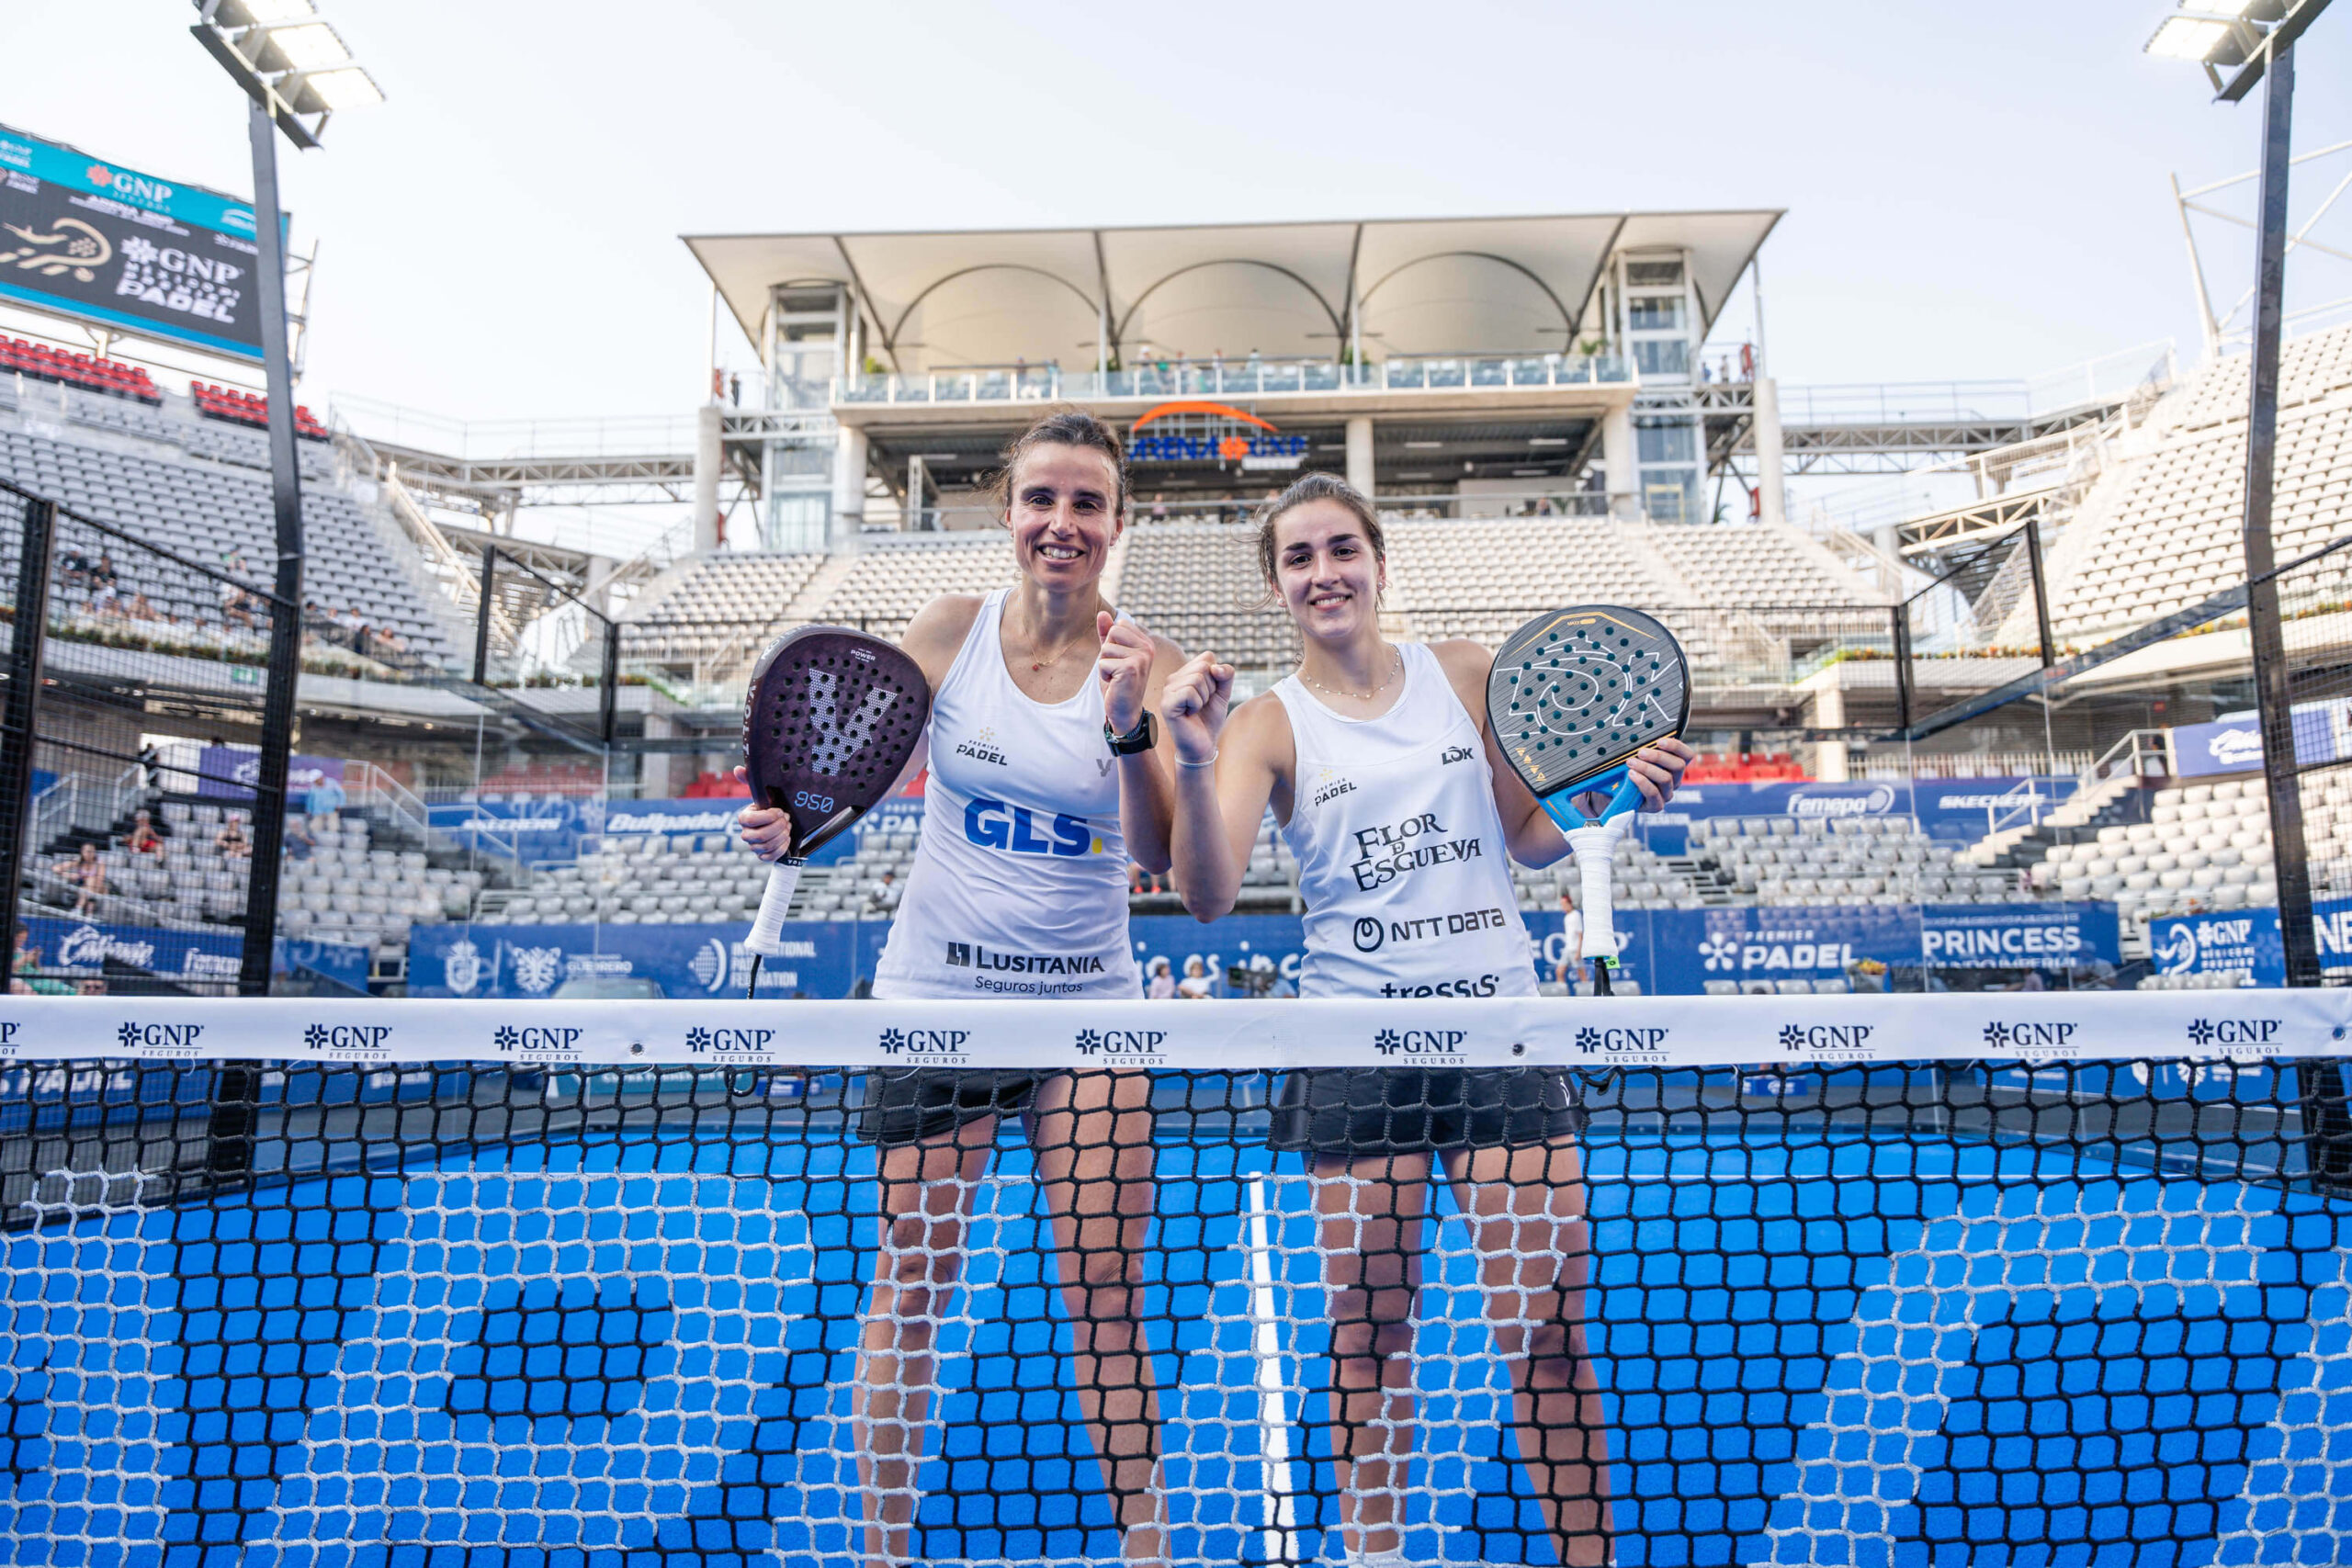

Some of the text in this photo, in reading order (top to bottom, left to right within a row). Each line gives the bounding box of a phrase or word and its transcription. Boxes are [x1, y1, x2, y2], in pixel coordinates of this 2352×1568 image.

[113, 172, 173, 202] GNP
[159, 247, 240, 286] GNP
[116, 276, 235, 324] PADEL
[956, 743, 1008, 766] PADEL
[795, 790, 835, 814] 950
[1314, 781, 1358, 807] PADEL
[1352, 813, 1448, 860] FLOR
[1350, 838, 1482, 892] ESGUEVA
[1390, 917, 1443, 942] NTT
[1744, 929, 1815, 942] PREMIER
[2213, 919, 2253, 945] GNP
[1922, 926, 2082, 956] PRINCESS
[977, 945, 1105, 976] LUSITANIA
[1742, 943, 1860, 971] PADEL
[975, 976, 1083, 996] Seguros juntos
[144, 1024, 204, 1045] GNP
[332, 1026, 389, 1047] GNP
[522, 1028, 580, 1049] GNP
[714, 1029, 772, 1051] GNP
[908, 1031, 967, 1052] GNP
[1103, 1032, 1164, 1053] GNP
[1403, 1031, 1464, 1053] GNP
[1604, 1028, 1666, 1051] GNP
[1808, 1026, 1871, 1048] GNP
[2013, 1023, 2075, 1045] GNP
[2217, 1020, 2278, 1043] GNP
[141, 1049, 199, 1057] SEGUROS
[329, 1051, 388, 1060] SEGUROS
[519, 1053, 579, 1062] SEGUROS
[712, 1055, 772, 1064] SEGUROS
[906, 1056, 967, 1065] SEGUROS
[1103, 1057, 1164, 1066] SEGUROS
[1403, 1056, 1464, 1066] SEGUROS
[1605, 1055, 1668, 1064] SEGUROS
[1810, 1052, 1873, 1060] SEGUROS
[2220, 1046, 2280, 1055] SEGUROS
